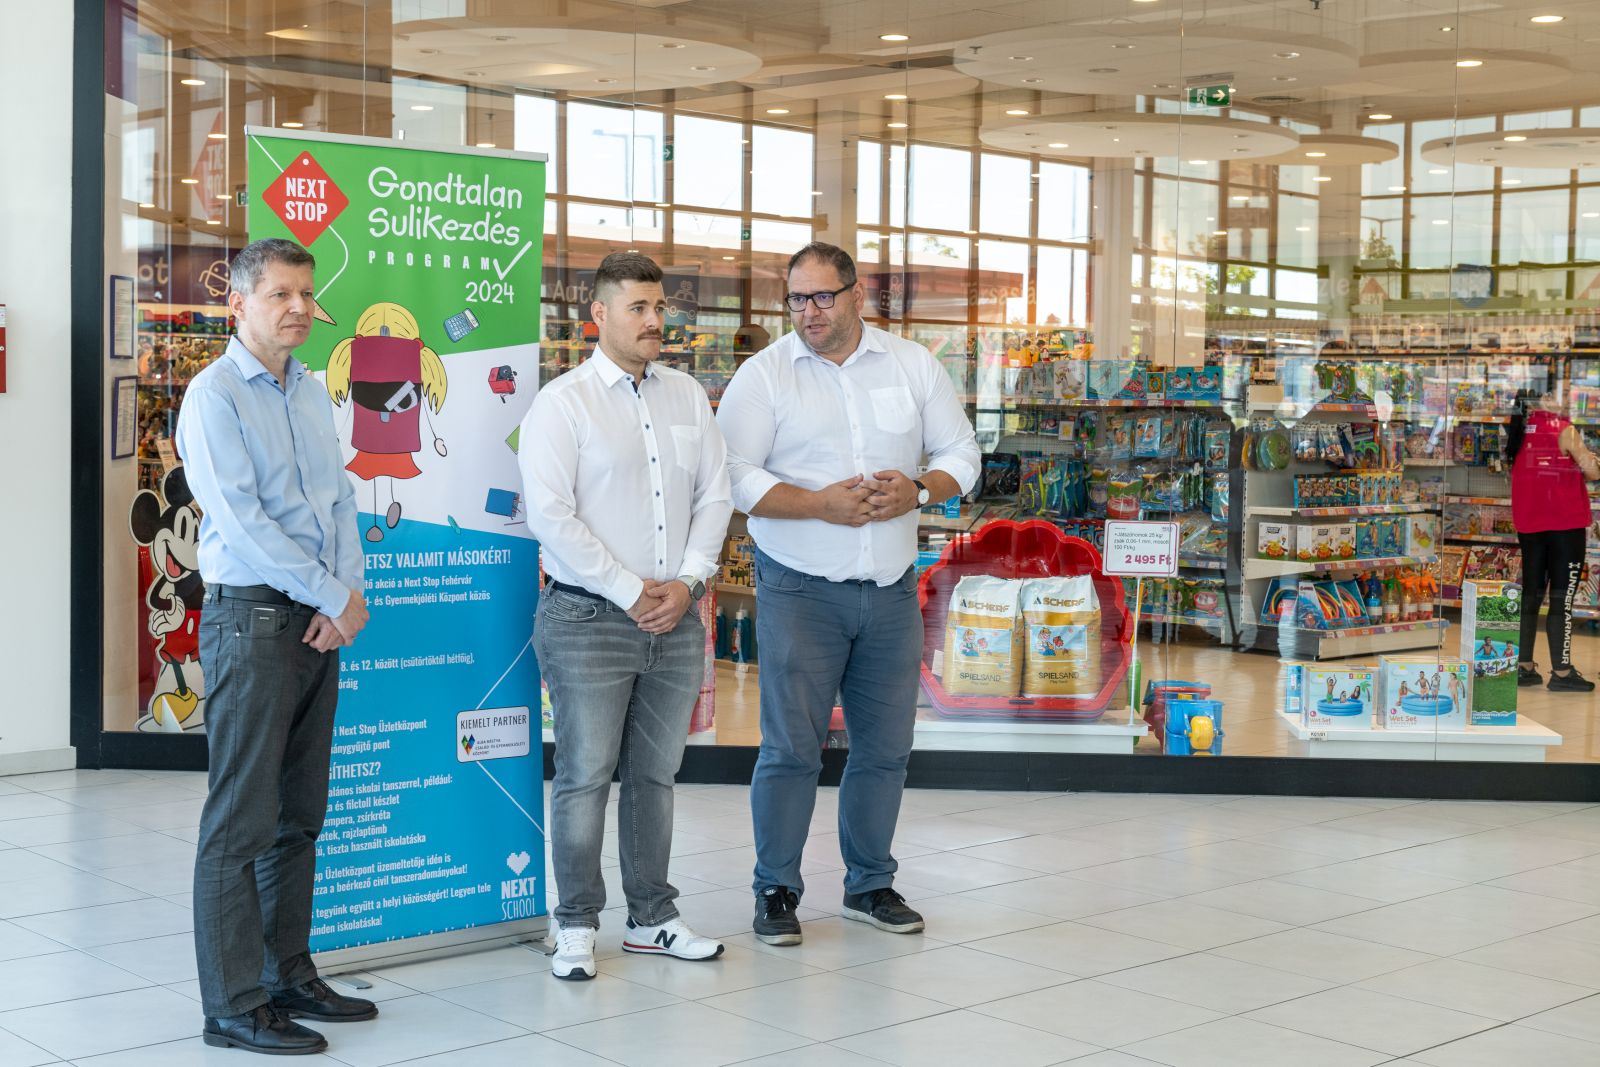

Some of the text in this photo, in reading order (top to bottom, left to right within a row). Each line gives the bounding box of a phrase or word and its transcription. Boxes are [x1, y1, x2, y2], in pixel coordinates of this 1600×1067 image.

[285, 177, 327, 199] NEXT
[367, 166, 523, 209] Gondtalan
[285, 200, 328, 222] STOP
[139, 256, 169, 286] ot
[465, 279, 515, 304] 2024
[364, 545, 511, 570] ETSZ VALAMIT MÁSOKÉRT!
[1125, 554, 1172, 565] 2 495 Ft
[365, 574, 472, 589] tő akció a Next Stop Fehérvár
[374, 595, 384, 606] és
[385, 592, 437, 607] Gyermekjóléti
[439, 591, 467, 605] Központ
[469, 590, 491, 601] közös
[1561, 570, 1579, 665] UNDER ARMOUR
[340, 661, 349, 672] 8.
[350, 661, 360, 672] és
[361, 660, 373, 671] 12.
[374, 658, 399, 670] között
[959, 671, 1001, 682] SPIELSAND
[1038, 671, 1080, 680] SPIELSAND
[339, 725, 357, 736] Next
[358, 723, 377, 736] Stop
[378, 718, 427, 733] Üzletközpont
[460, 714, 527, 730] KIEMELT PARTNER
[372, 739, 391, 752] pont
[328, 774, 453, 797] alános iskolai tanszerrel, például:
[335, 801, 344, 811] és
[346, 798, 371, 810] filctoll
[373, 794, 400, 807] készlet
[323, 810, 391, 828] empera, zsírkréta
[317, 824, 388, 842] zetek, rajzlaptömb
[327, 843, 349, 855] tiszta
[351, 838, 382, 852] használt
[384, 833, 427, 848] iskolatáska
[314, 852, 452, 883] op Üzletközpont üzemeltetője idén is
[313, 887, 328, 896] zza
[329, 885, 335, 894] a
[336, 877, 371, 893] beérkező
[372, 875, 389, 887] civil
[501, 877, 537, 900] NEXT
[316, 904, 348, 919] tegyünk
[349, 900, 375, 914] együtt
[376, 901, 381, 909] a
[382, 895, 401, 908] helyi
[402, 888, 449, 905] közösségért!
[450, 885, 476, 899] Legyen
[477, 882, 492, 894] tele
[501, 897, 537, 920] SCHOOL
[337, 914, 383, 932] iskolatáska!
[653, 929, 678, 949] N
